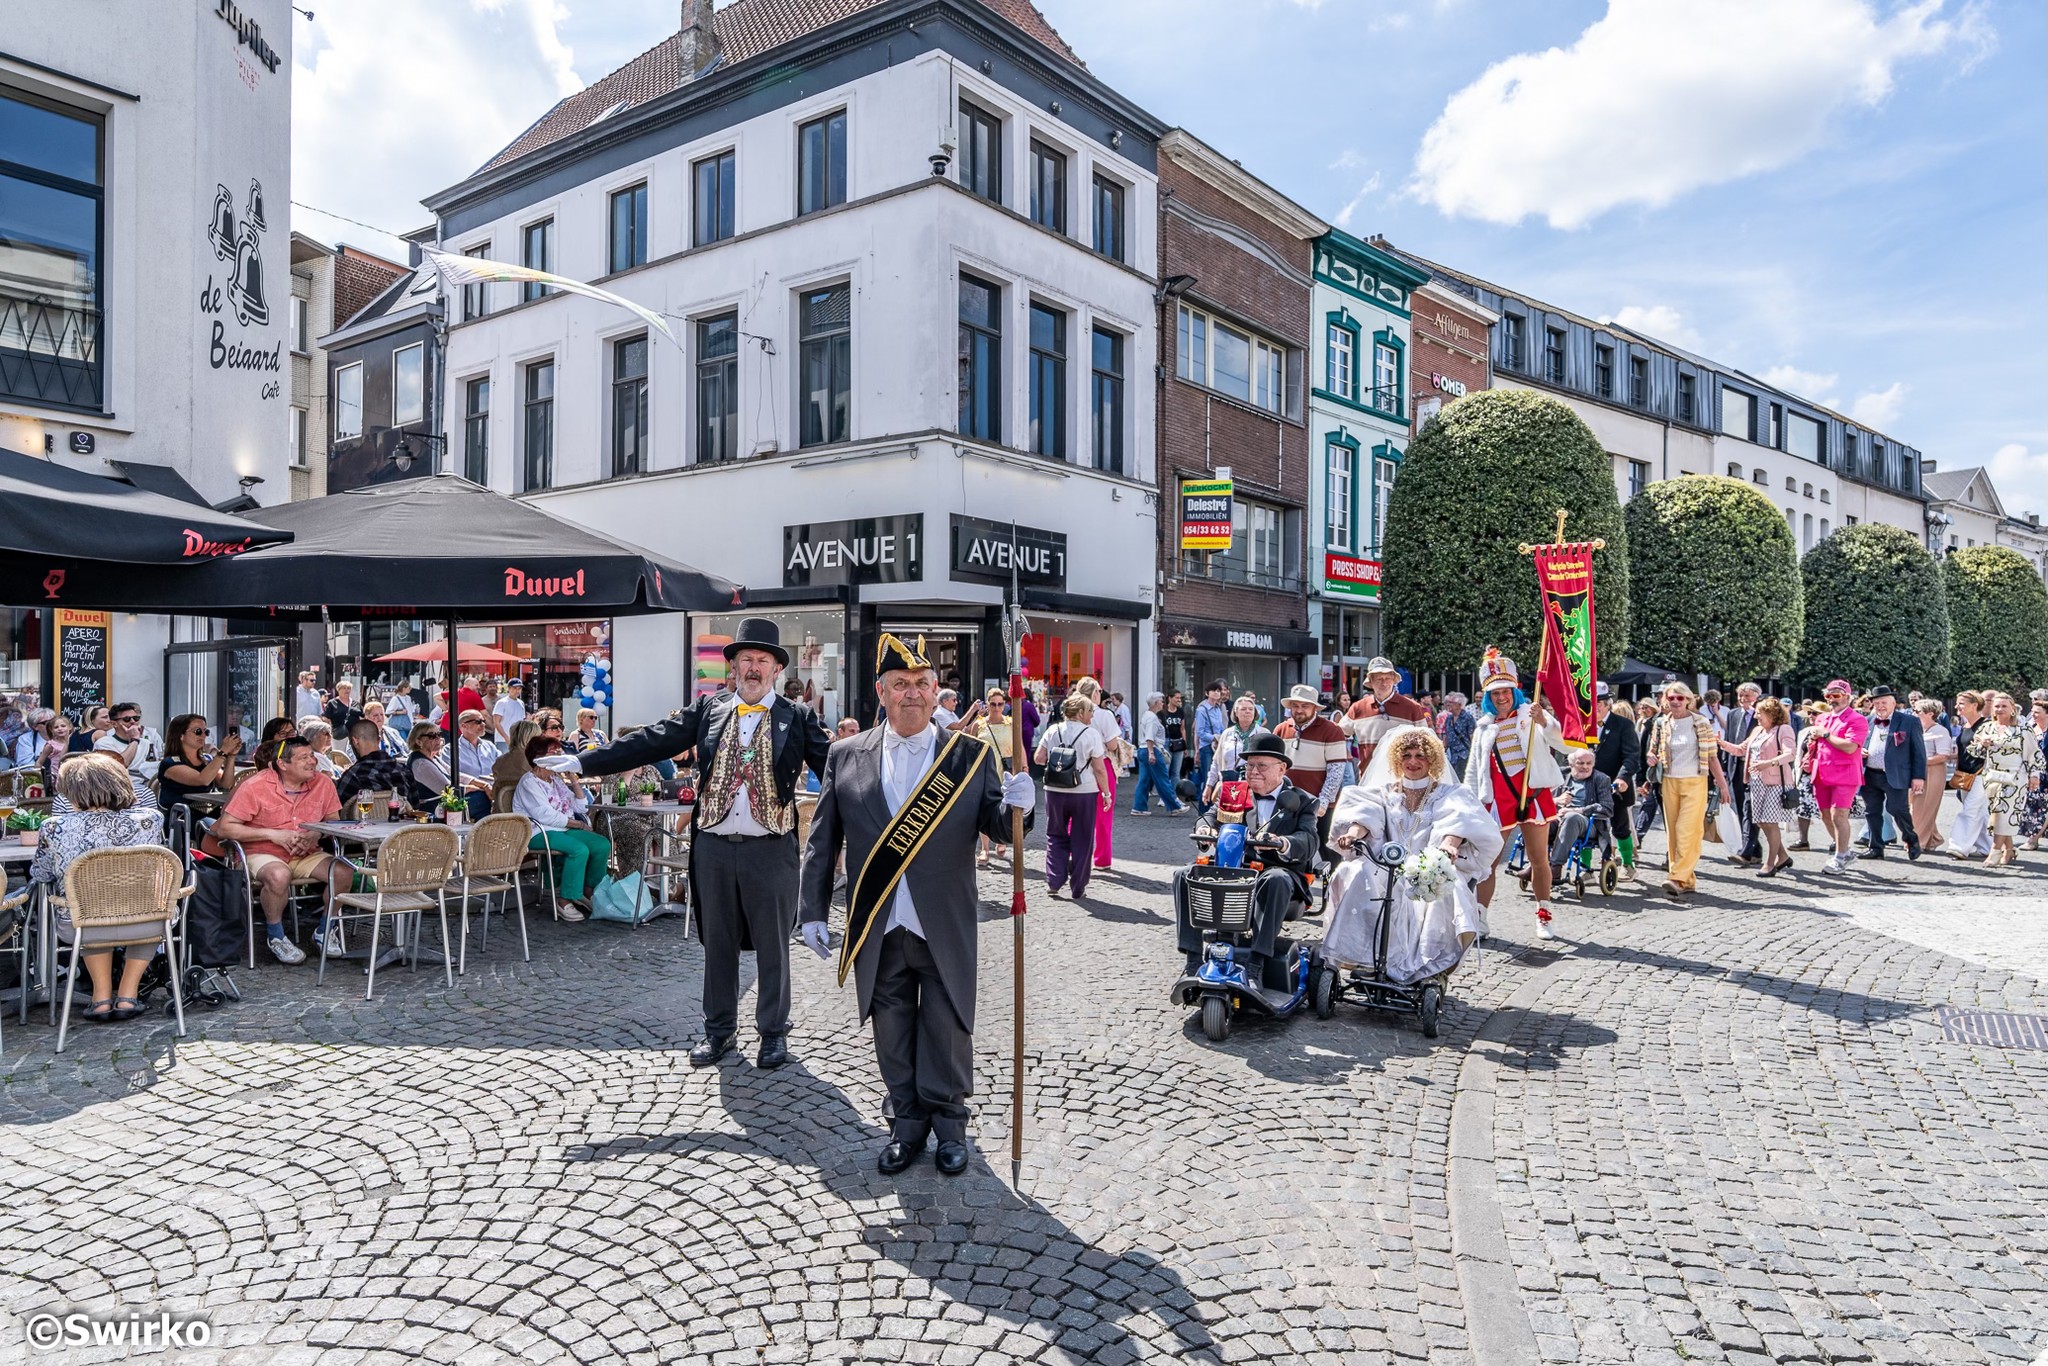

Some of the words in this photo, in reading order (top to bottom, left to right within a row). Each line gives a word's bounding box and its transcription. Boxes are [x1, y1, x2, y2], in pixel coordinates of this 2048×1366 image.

[200, 274, 223, 314] de
[1434, 313, 1470, 340] Affligem
[210, 320, 281, 372] Beiaard
[1187, 498, 1227, 511] Delestré
[183, 528, 251, 557] Duvel
[1184, 525, 1209, 535] 054/33
[1210, 526, 1220, 535] 62
[1221, 526, 1230, 535] 52
[787, 535, 897, 570] AVENUE
[906, 533, 917, 562] 1
[968, 537, 1051, 574] AVENUE
[1056, 552, 1065, 577] 1
[504, 567, 585, 597] Duvel
[1356, 564, 1374, 580] SHOP
[63, 609, 105, 623] Duvel
[67, 627, 100, 639] APERO
[1227, 631, 1273, 650] FREEDOM
[64, 651, 96, 661] martini
[887, 770, 955, 857] KERKBALJUW
